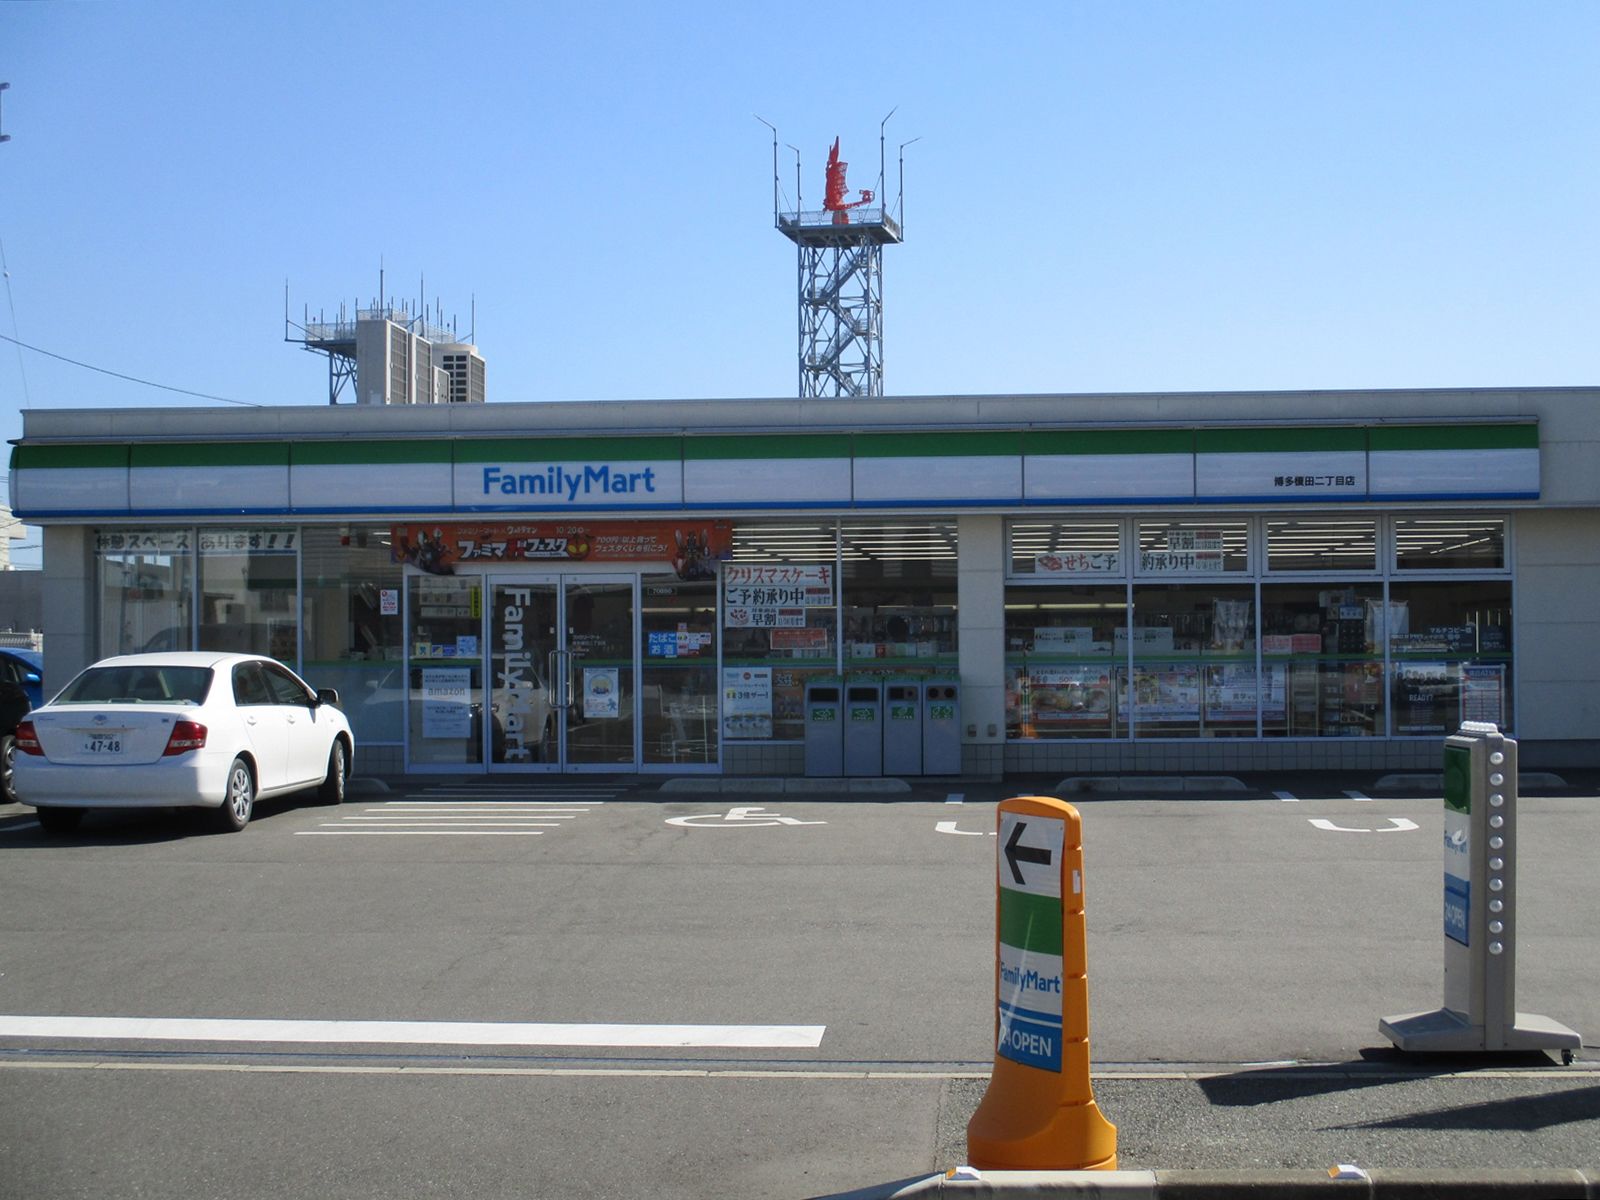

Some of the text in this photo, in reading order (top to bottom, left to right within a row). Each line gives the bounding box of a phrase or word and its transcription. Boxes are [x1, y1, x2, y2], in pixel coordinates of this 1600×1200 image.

[483, 465, 656, 501] FamilyMart
[728, 566, 830, 584] クリスマスケーキ
[726, 587, 804, 605] ご予約承り中
[752, 613, 777, 626] 早割
[649, 633, 676, 643] たばこ
[497, 588, 532, 760] FamilyMart
[428, 688, 465, 697] amazon
[91, 740, 121, 753] 47-48
[1000, 961, 1061, 994] FamilyMart
